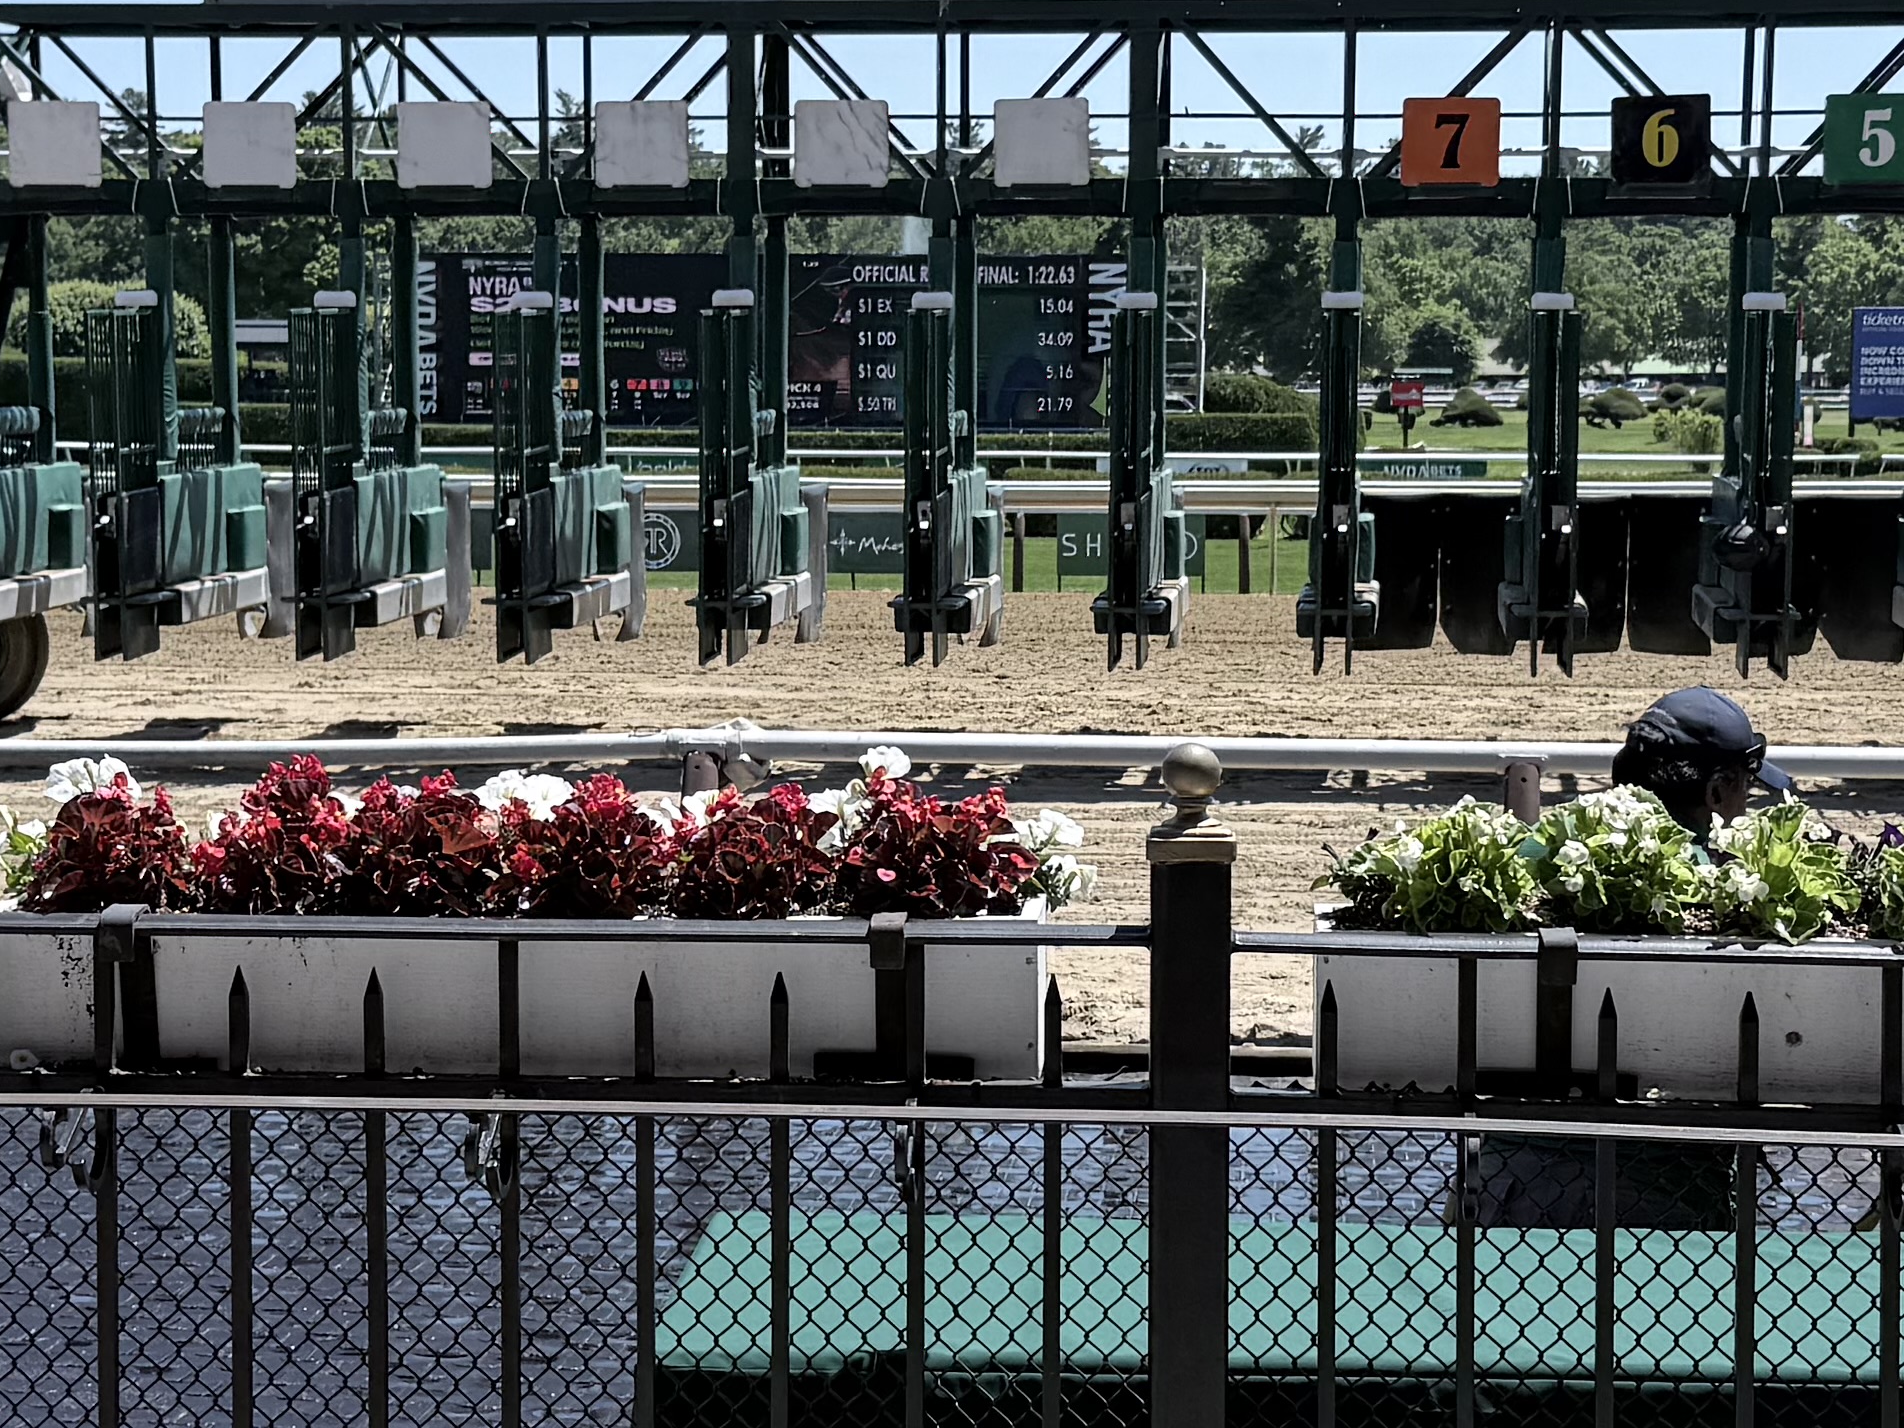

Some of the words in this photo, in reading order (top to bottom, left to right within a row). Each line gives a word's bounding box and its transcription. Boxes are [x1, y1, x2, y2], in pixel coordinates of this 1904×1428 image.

[1432, 113, 1474, 169] 7
[1642, 109, 1679, 166] 6
[1858, 109, 1896, 168] 5
[853, 265, 914, 283] OFFICIAL
[977, 266, 1019, 284] FINAL:
[1028, 265, 1075, 284] 1:22.63
[1040, 298, 1074, 314] 15.04
[1037, 332, 1074, 347] 34.09
[787, 384, 811, 393] ICK
[1037, 396, 1073, 412] 21.79
